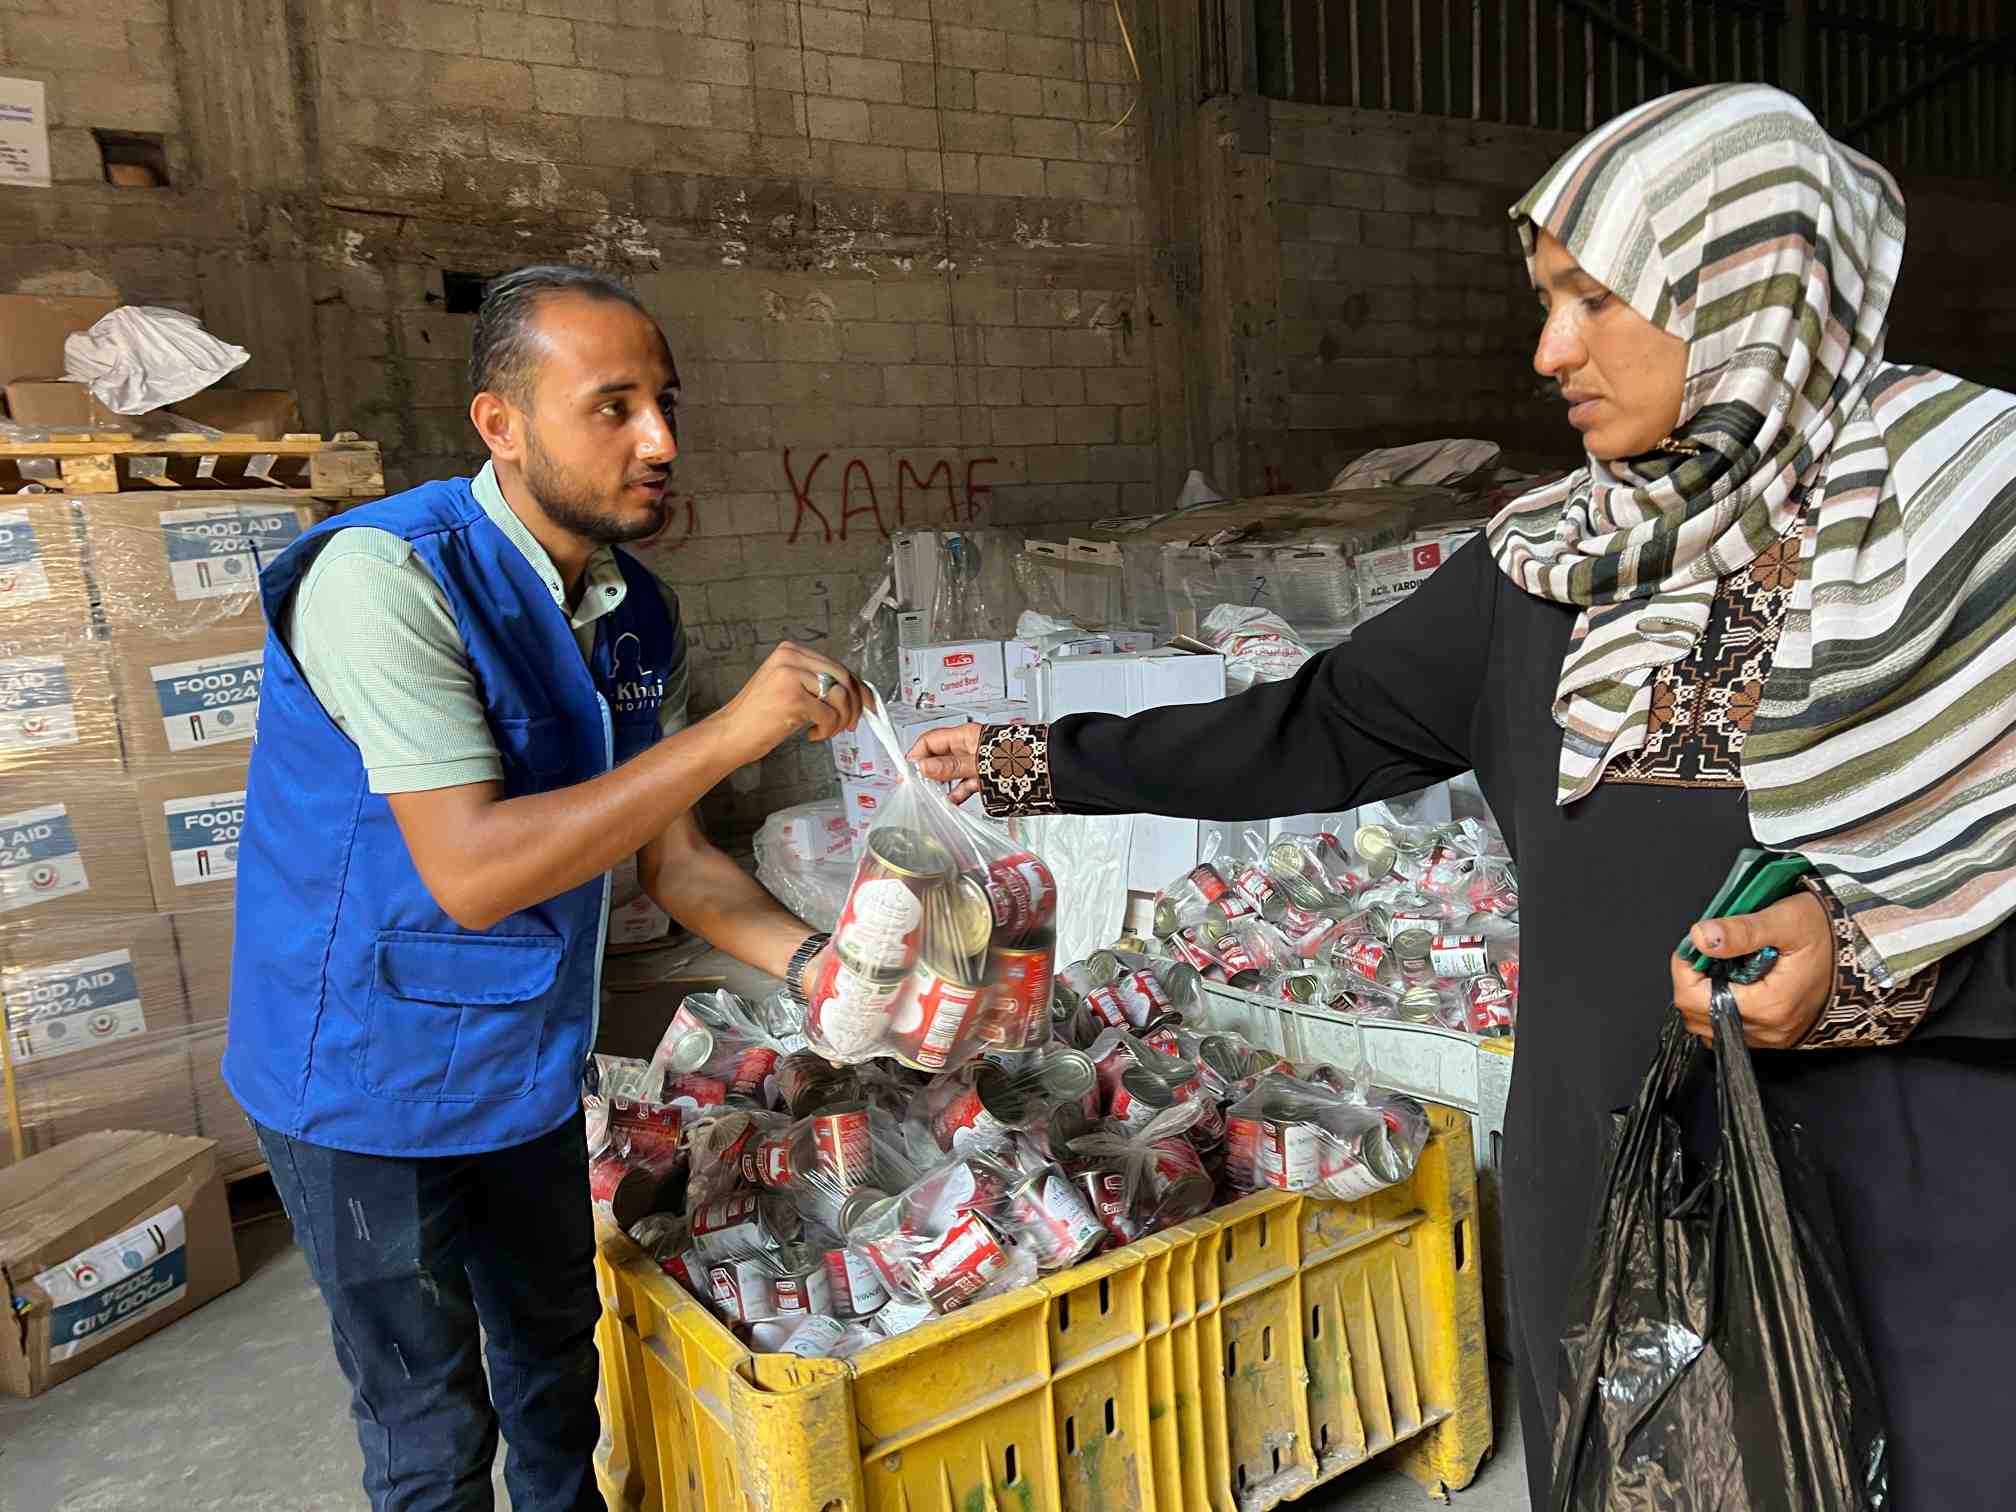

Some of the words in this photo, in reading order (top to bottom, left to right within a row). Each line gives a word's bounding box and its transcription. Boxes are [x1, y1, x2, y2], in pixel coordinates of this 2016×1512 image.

[180, 522, 242, 538] FOOD
[247, 517, 282, 534] AID
[173, 673, 237, 696] FOOD
[201, 685, 258, 707] 2024
[184, 809, 246, 830] FOOD
[11, 824, 51, 847] AID
[211, 826, 240, 842] 20
[75, 971, 116, 993] AID
[117, 1272, 175, 1315] FOOD
[72, 1309, 114, 1336] AID
